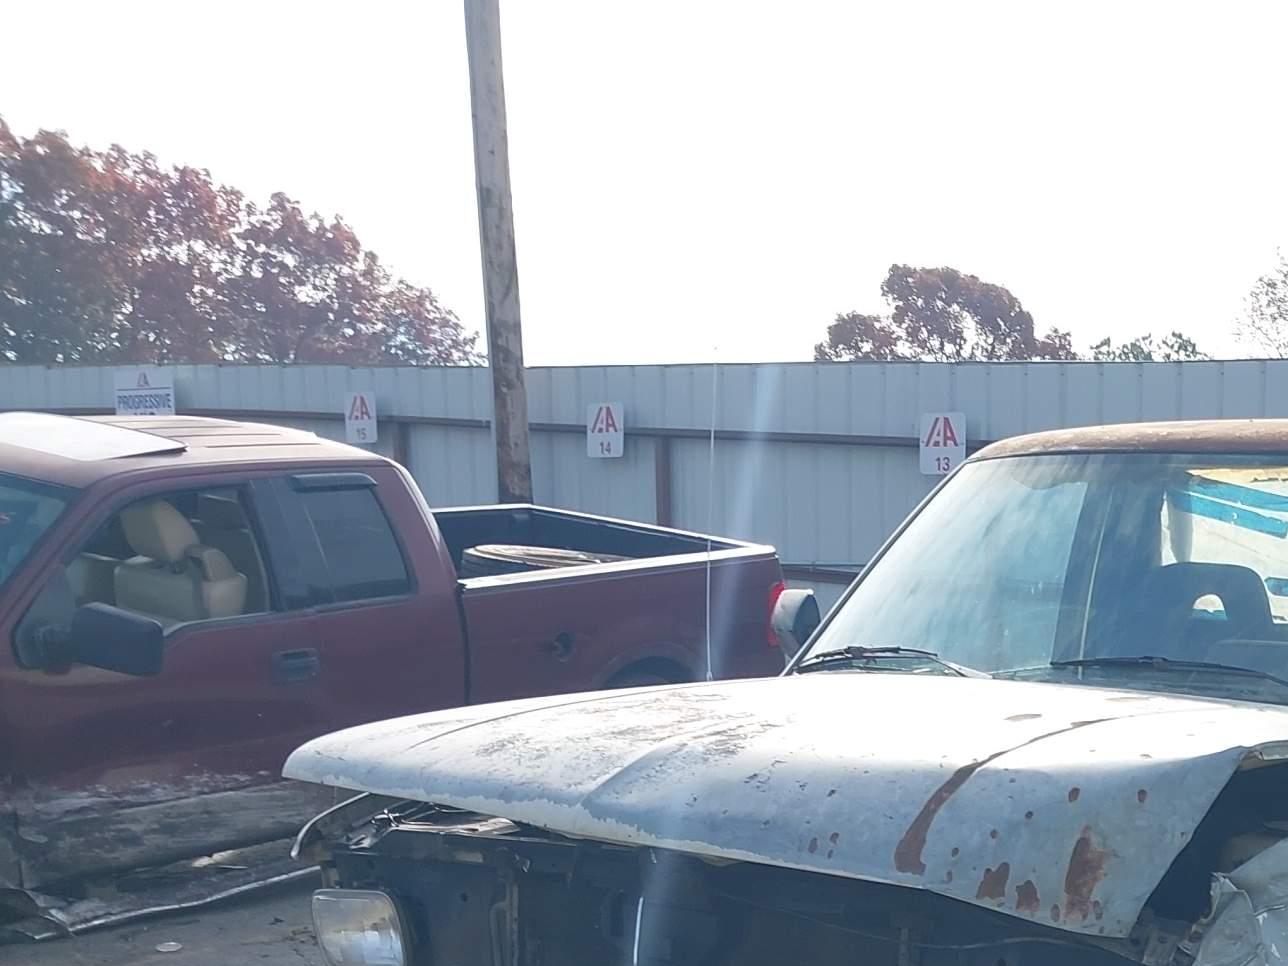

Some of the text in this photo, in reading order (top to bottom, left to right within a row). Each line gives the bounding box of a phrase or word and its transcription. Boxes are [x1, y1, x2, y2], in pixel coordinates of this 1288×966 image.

[117, 394, 172, 409] PROGRESSIVE
[356, 428, 367, 440] 15
[600, 441, 612, 455] 14
[935, 457, 951, 471] 13
